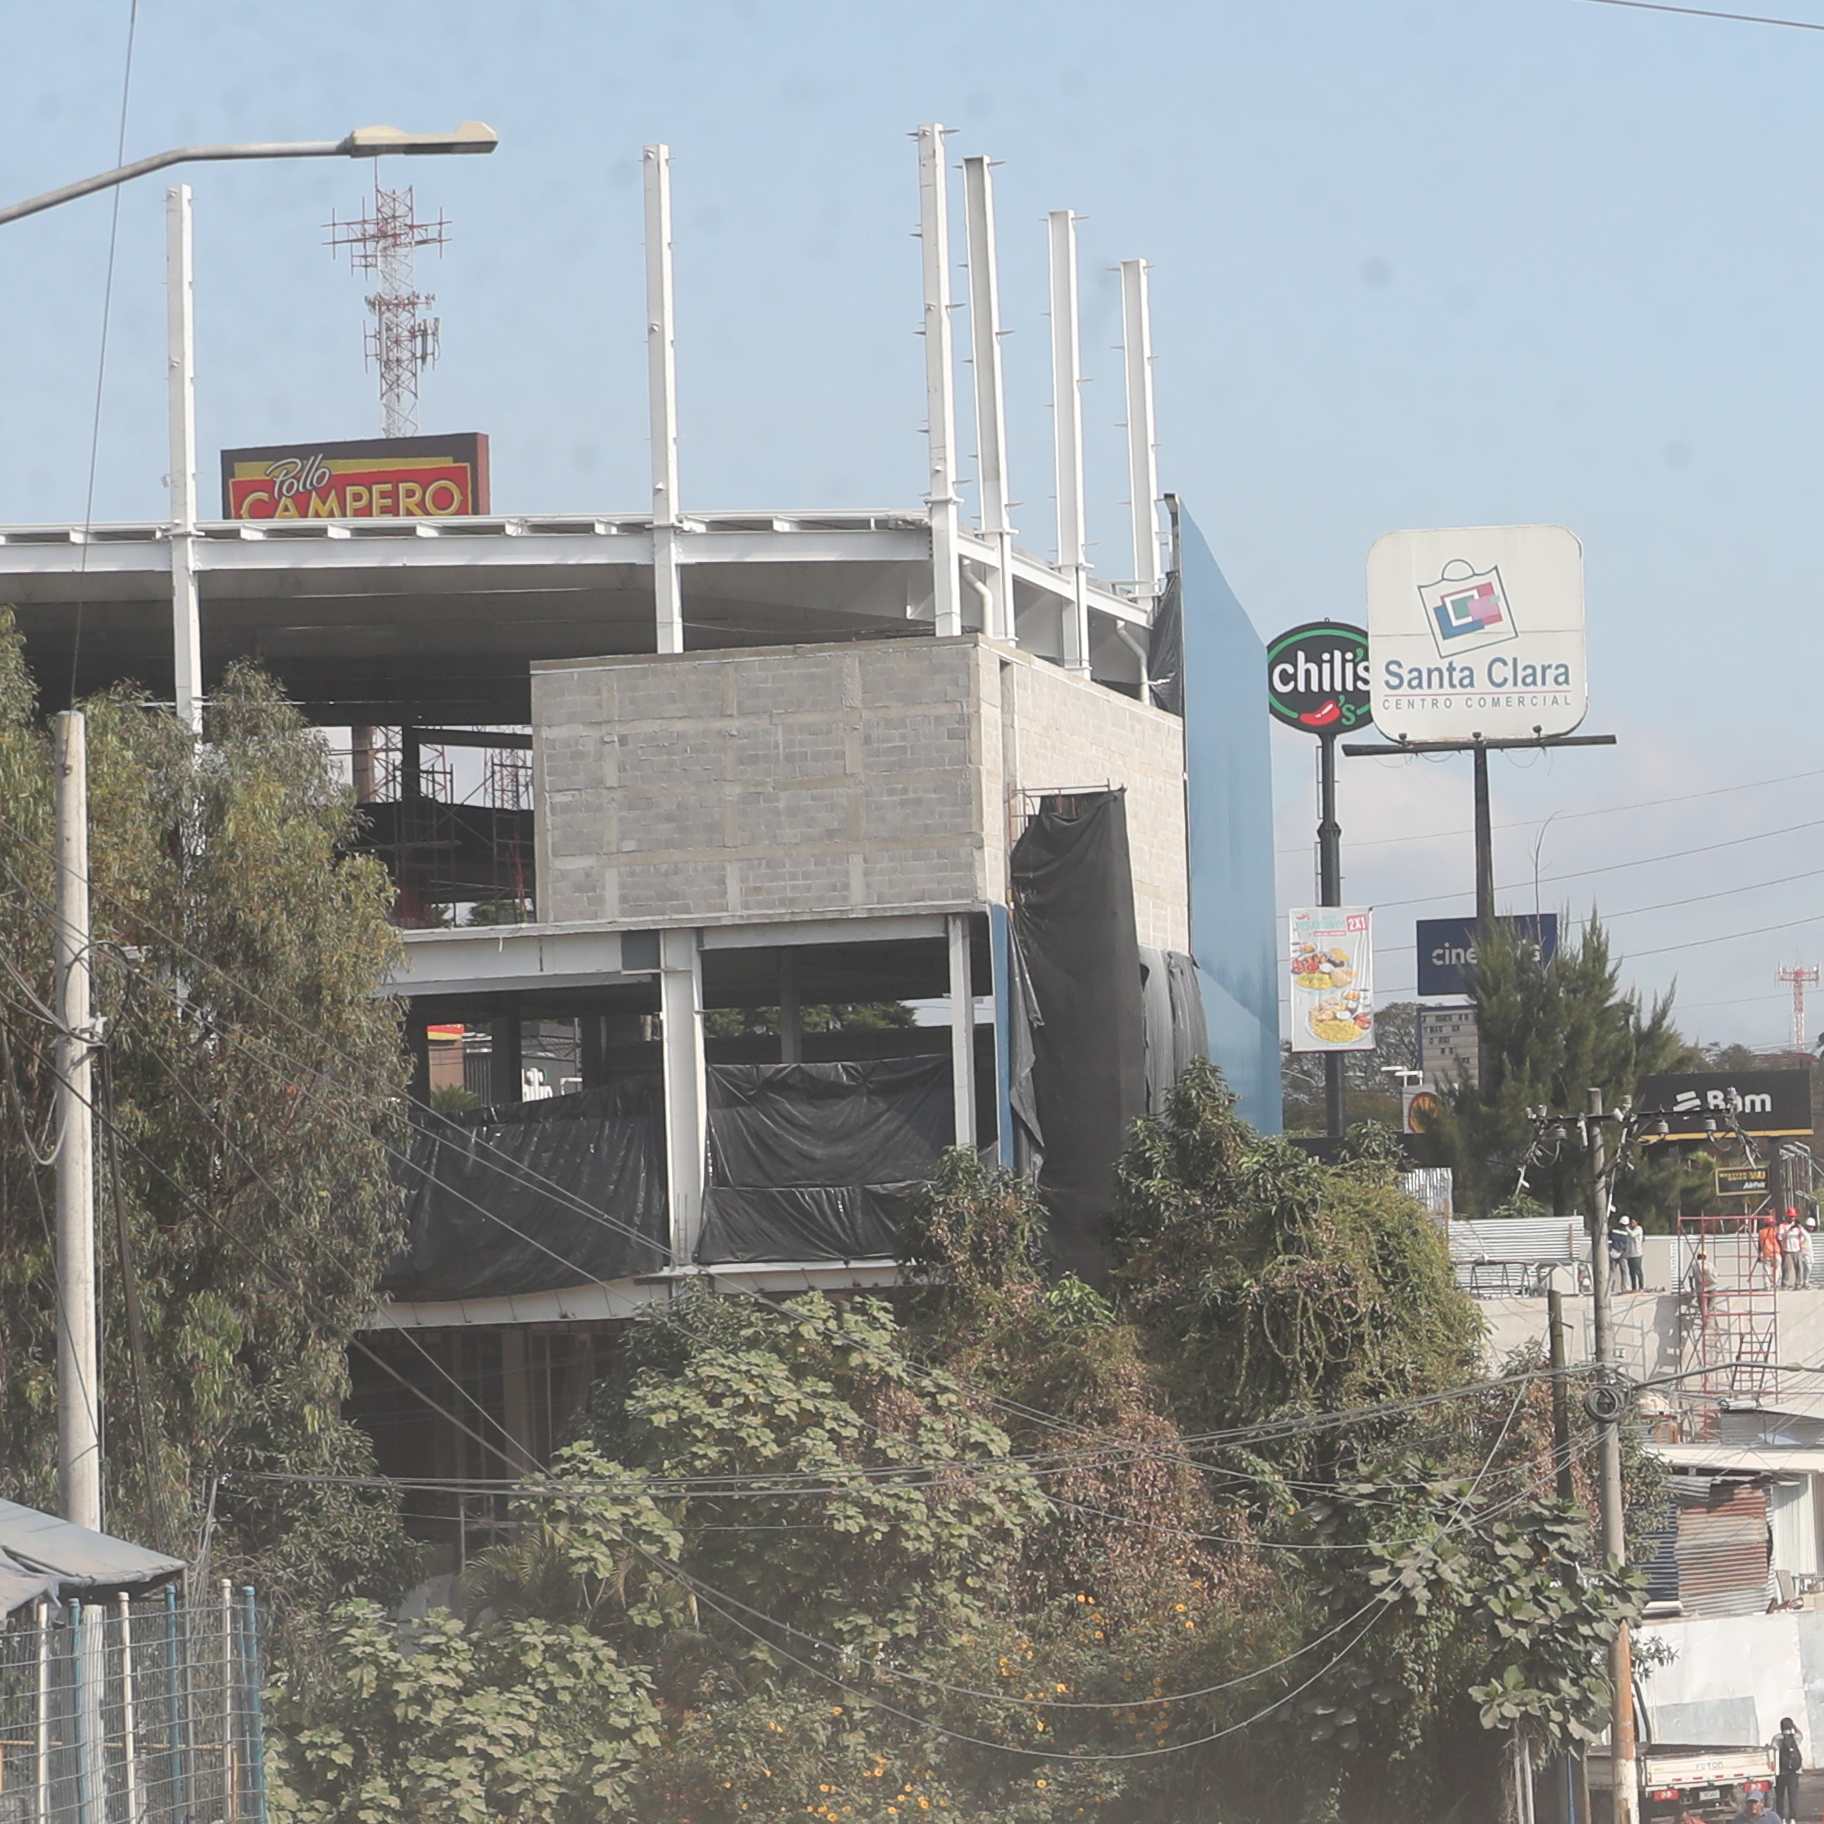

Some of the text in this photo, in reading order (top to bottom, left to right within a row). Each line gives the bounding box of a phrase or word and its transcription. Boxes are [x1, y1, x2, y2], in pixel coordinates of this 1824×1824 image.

[266, 453, 330, 498] Pollo
[240, 480, 463, 519] CAMPERO
[1384, 656, 1570, 690] Santa Clara
[1382, 695, 1572, 711] CENTRO COMERCIAL
